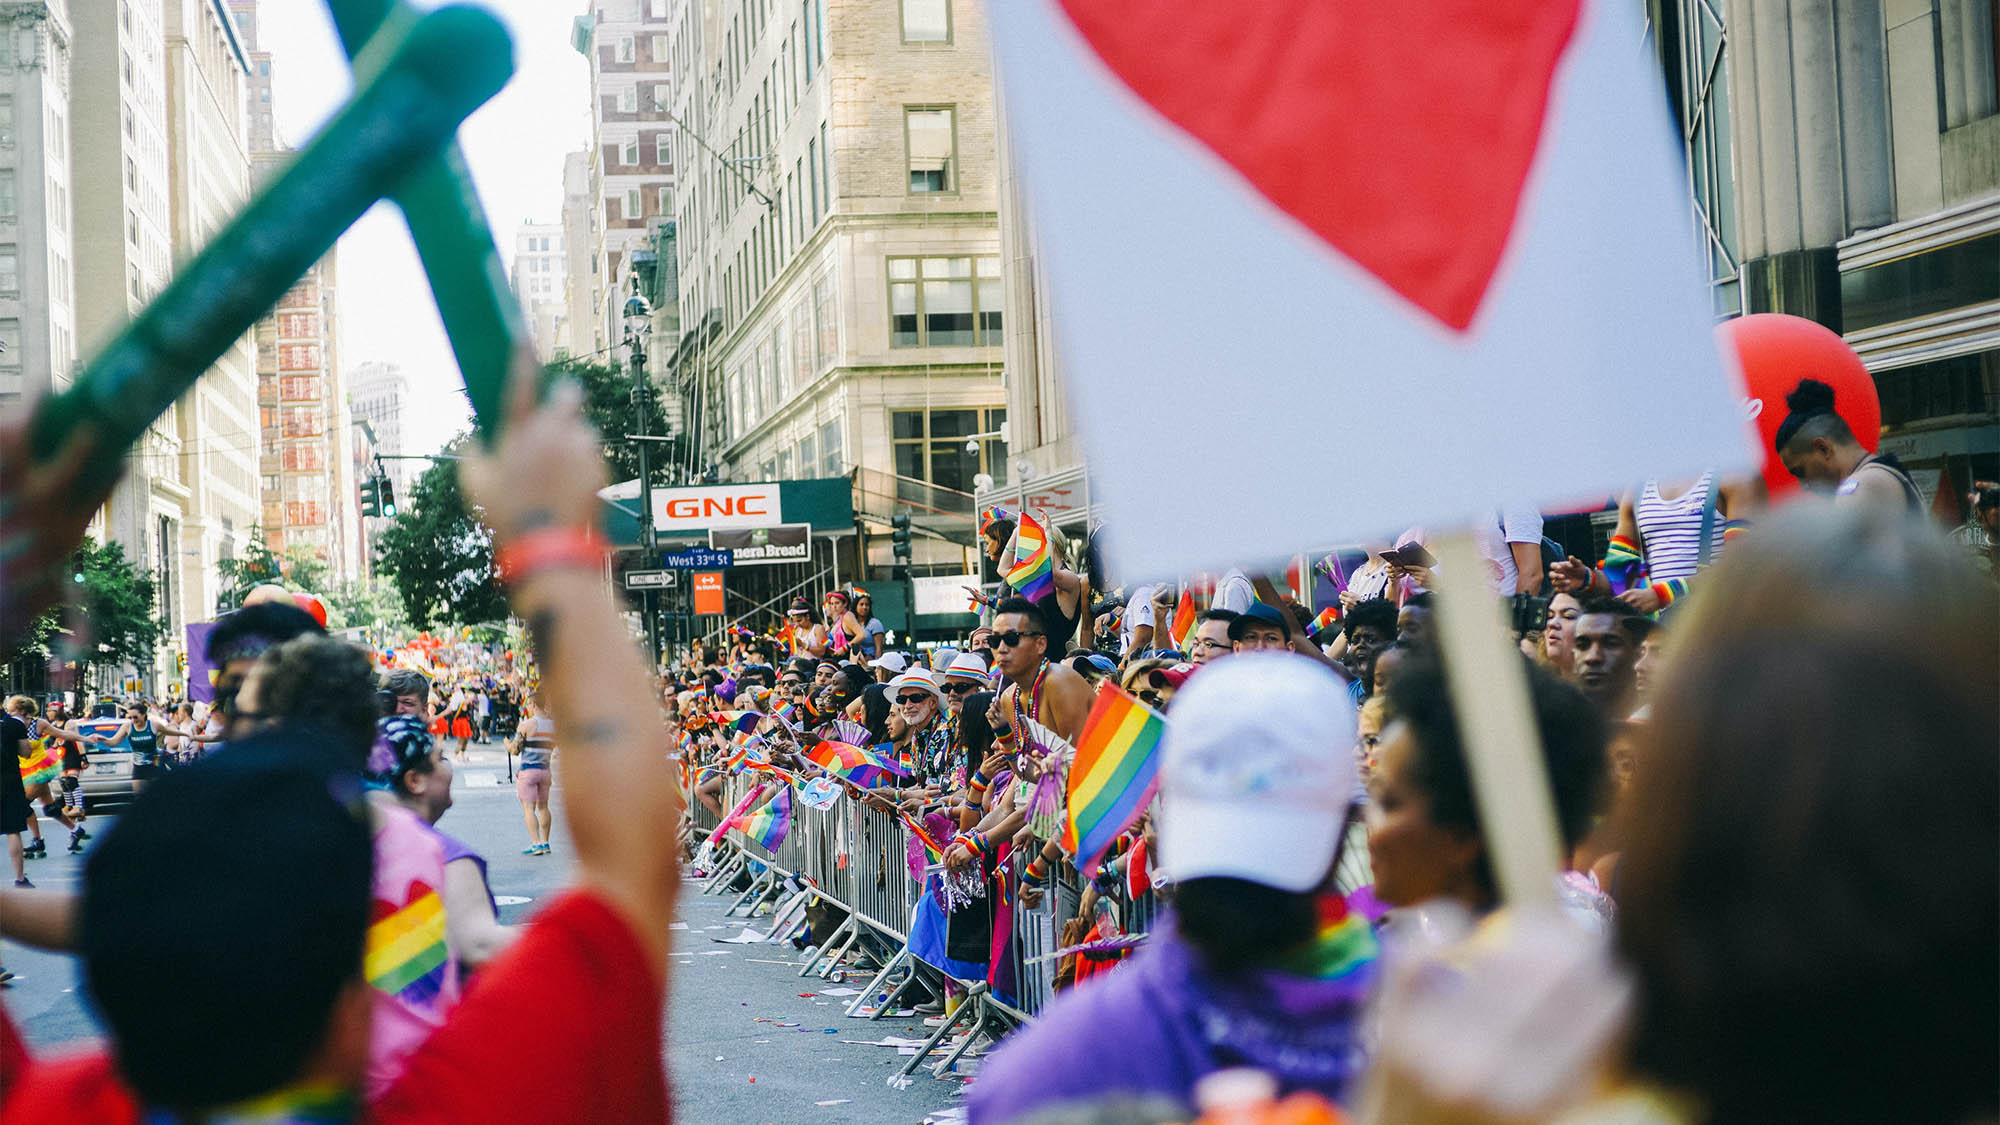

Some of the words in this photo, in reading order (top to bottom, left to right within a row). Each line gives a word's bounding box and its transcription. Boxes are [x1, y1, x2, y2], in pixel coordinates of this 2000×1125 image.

[666, 496, 767, 518] GNC
[765, 543, 806, 557] Bread
[668, 555, 694, 566] West
[696, 554, 715, 566] 33rd
[717, 554, 728, 565] St
[633, 576, 647, 584] ONE
